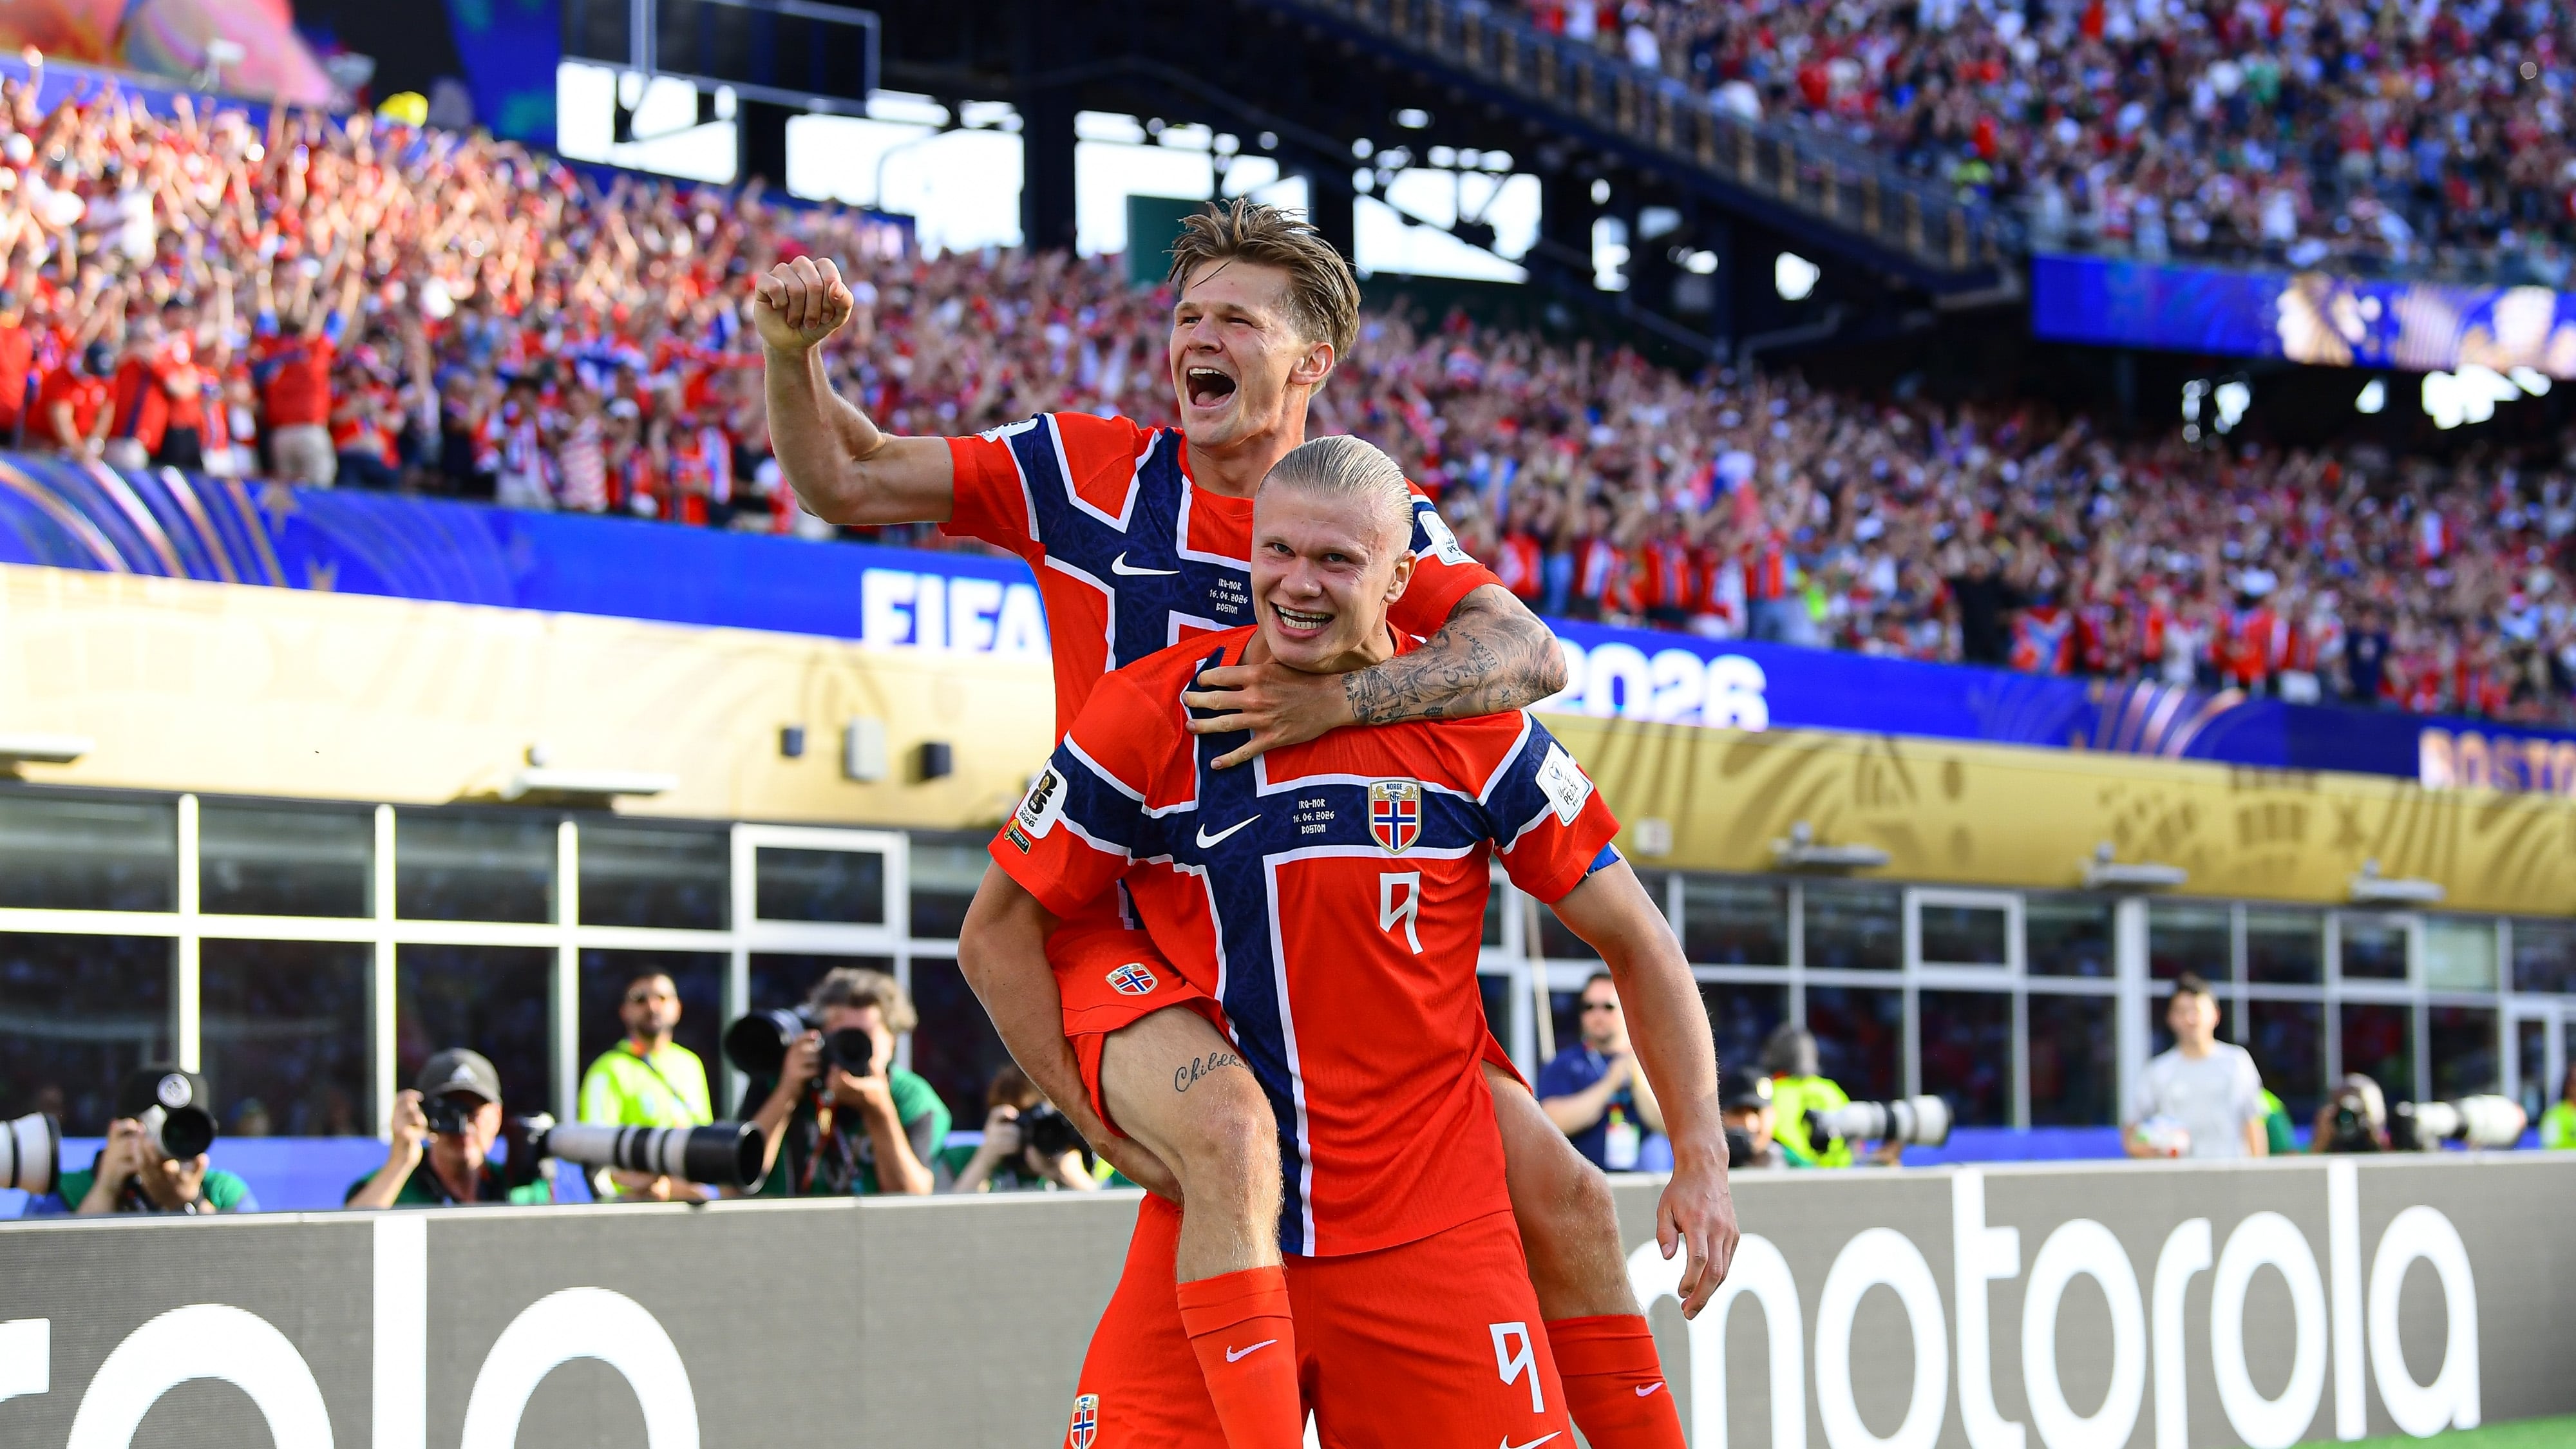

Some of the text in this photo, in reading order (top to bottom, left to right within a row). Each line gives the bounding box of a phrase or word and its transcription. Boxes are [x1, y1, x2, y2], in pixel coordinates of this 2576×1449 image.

[1218, 578, 1242, 591] IRQ-NOR
[860, 567, 1052, 659] FIFA
[1216, 602, 1238, 615] BOSTON
[1298, 799, 1326, 810] IRQ-NOR
[1019, 810, 1036, 828] 2026
[1293, 811, 1335, 824] 16.06.2026
[1012, 829, 1029, 847] DEBUT
[1301, 824, 1326, 835] BOSTON
[1379, 871, 1425, 955] 9
[1627, 1159, 2481, 1449] motorola
[1488, 1321, 1546, 1414] 9
